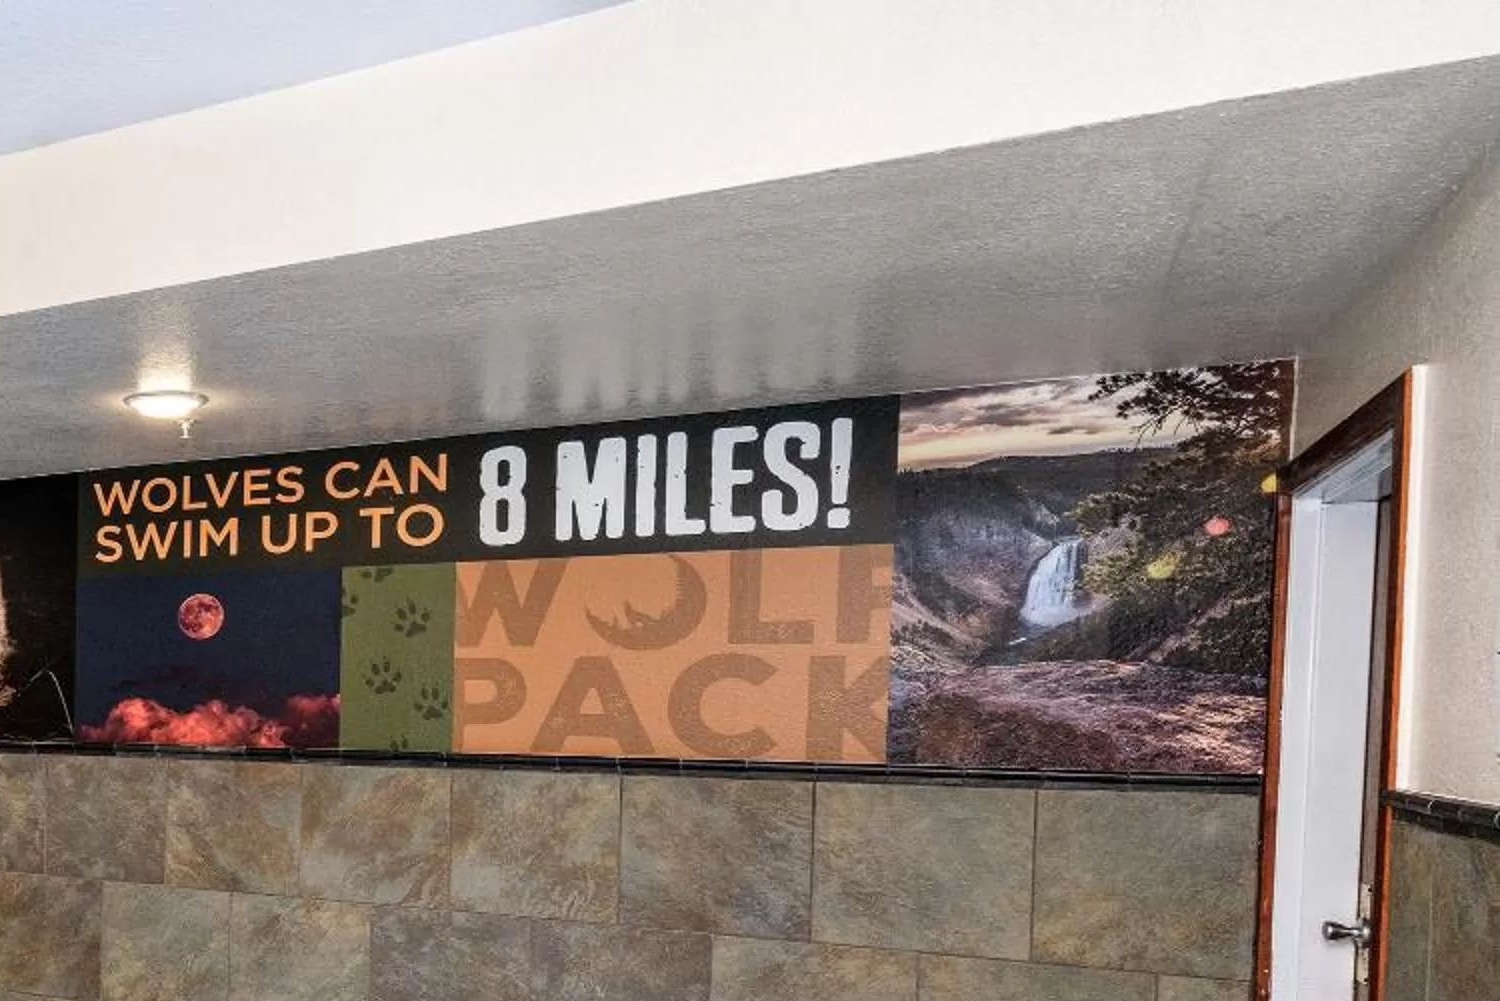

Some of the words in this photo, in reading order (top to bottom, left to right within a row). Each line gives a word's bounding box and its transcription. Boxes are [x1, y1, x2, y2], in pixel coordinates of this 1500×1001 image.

[94, 465, 305, 517] WOLVES
[325, 453, 448, 500] CAN
[479, 445, 528, 546] 8
[555, 417, 853, 542] MILES!
[95, 517, 240, 564] SWIM
[261, 511, 339, 555] UP
[359, 503, 446, 549] TO
[453, 652, 890, 762] PACK
